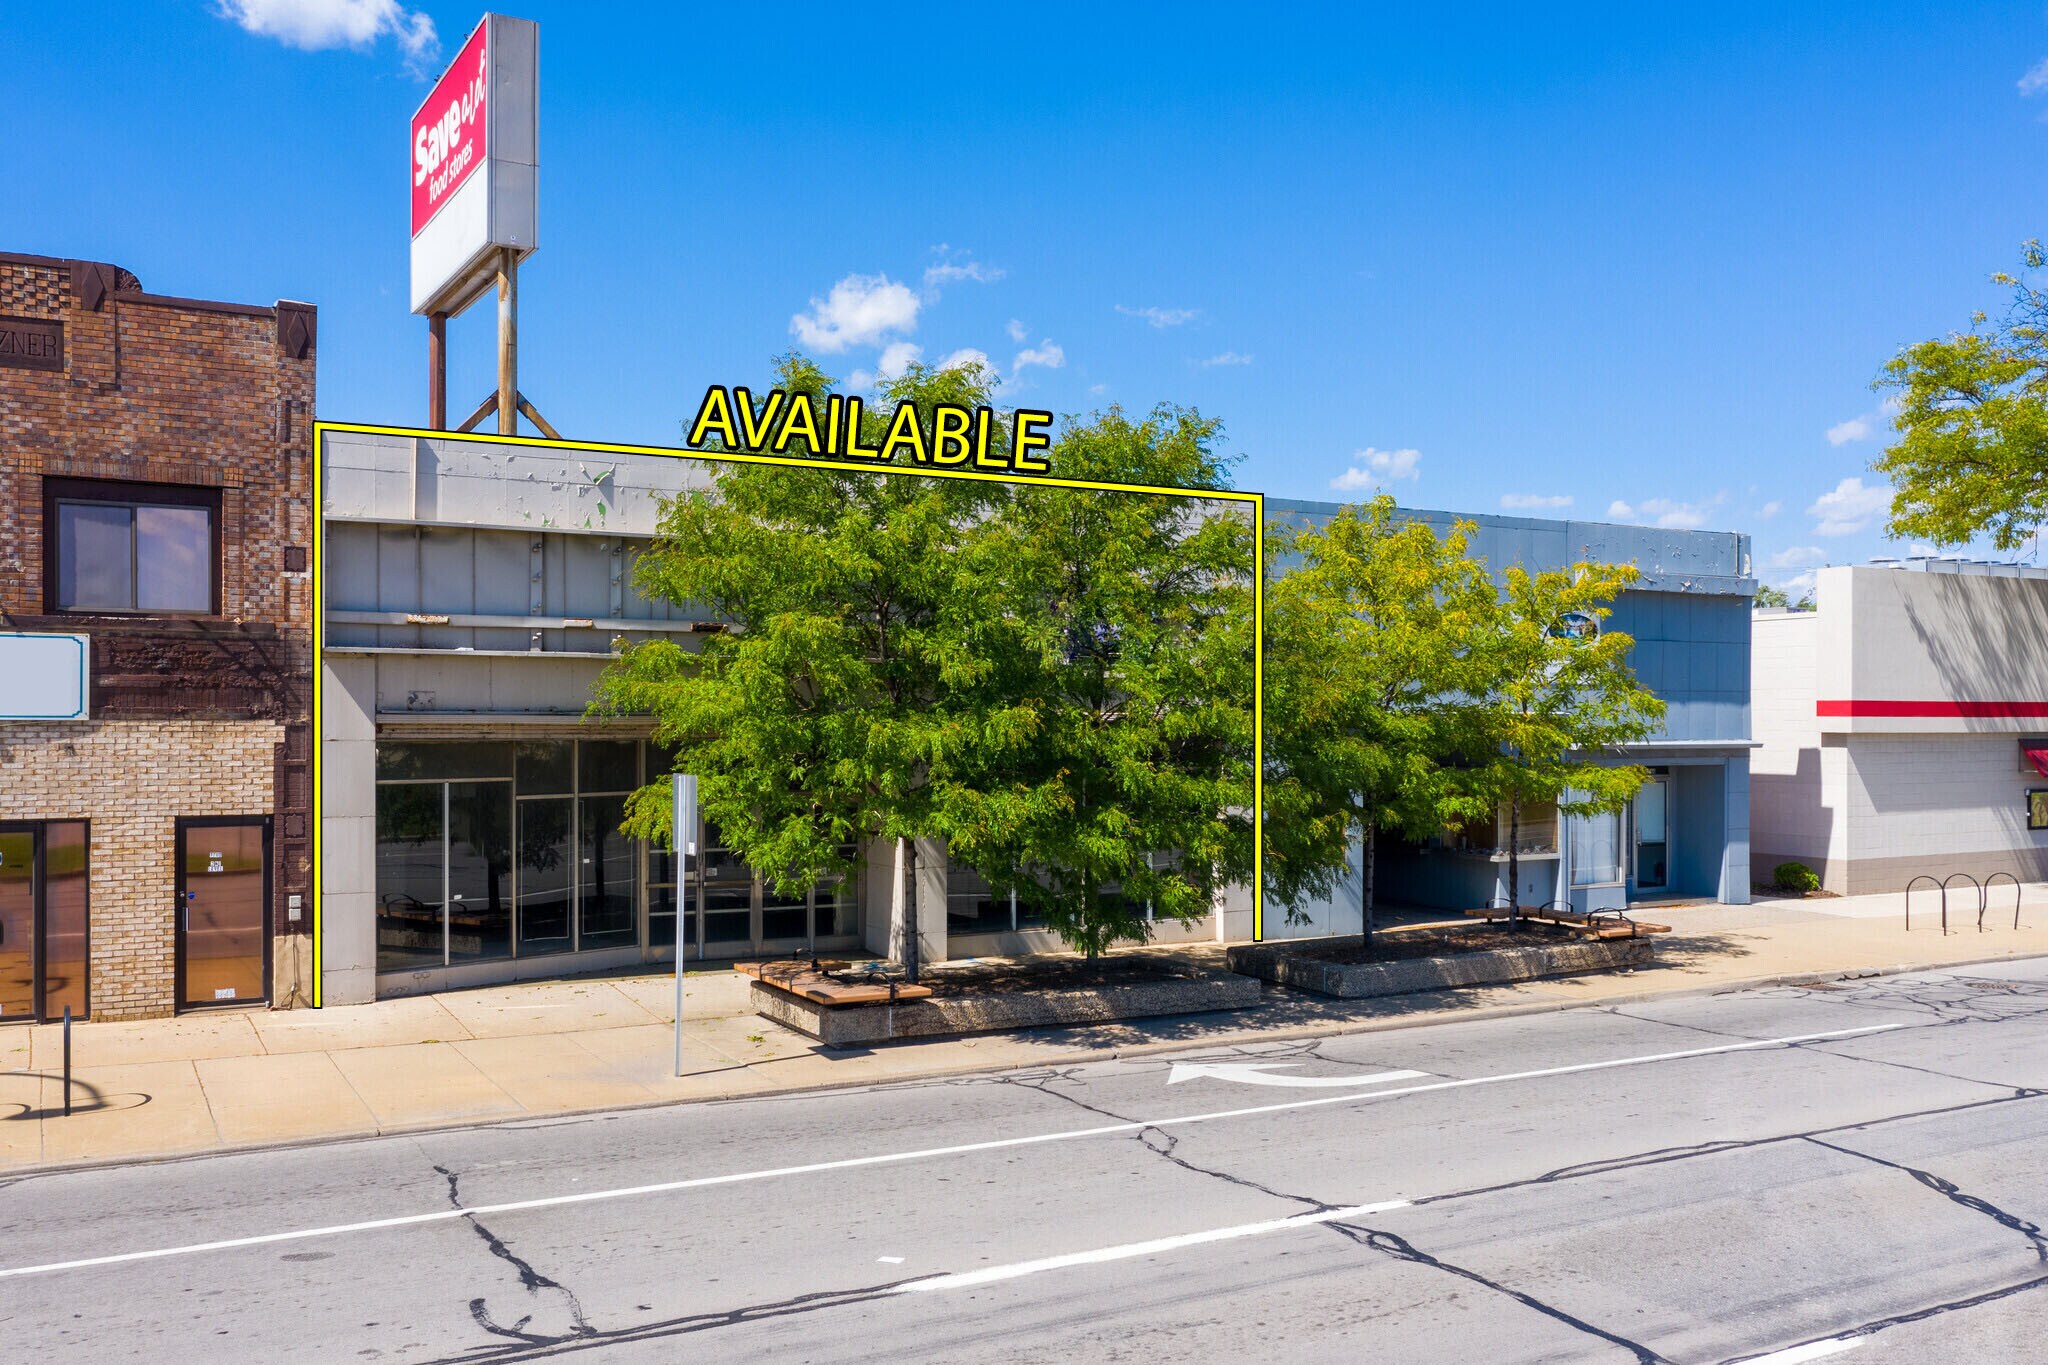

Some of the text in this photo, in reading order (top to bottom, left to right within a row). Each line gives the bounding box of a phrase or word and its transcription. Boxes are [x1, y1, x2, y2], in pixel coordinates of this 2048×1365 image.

[415, 100, 460, 186] Save
[429, 138, 473, 205] food stores
